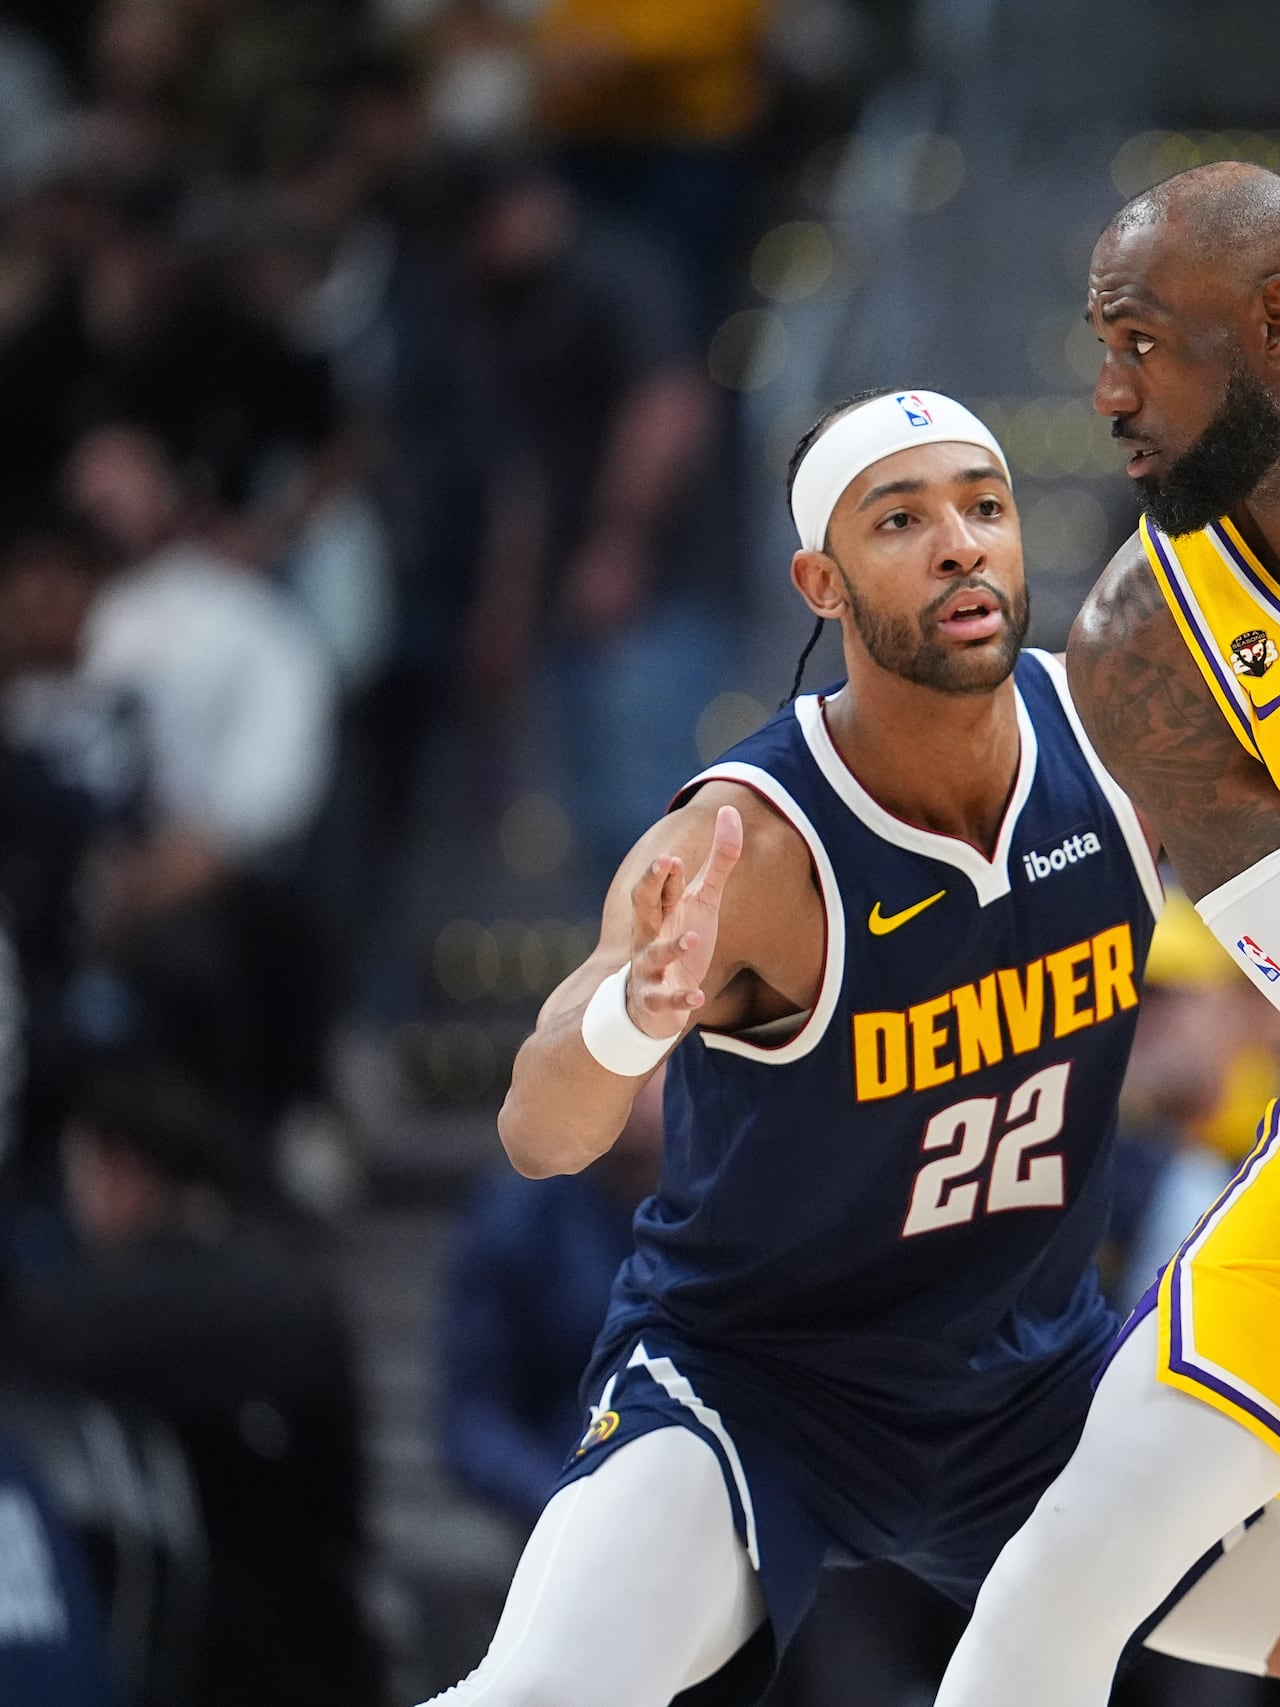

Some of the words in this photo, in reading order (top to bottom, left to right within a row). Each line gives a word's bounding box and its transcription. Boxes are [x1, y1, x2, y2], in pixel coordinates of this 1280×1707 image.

[1232, 633, 1266, 650] SEASONS
[1235, 631, 1260, 644] NBA
[1023, 830, 1101, 883] ibotta
[852, 922, 1138, 1104] DENVER
[902, 1060, 1072, 1238] 22
